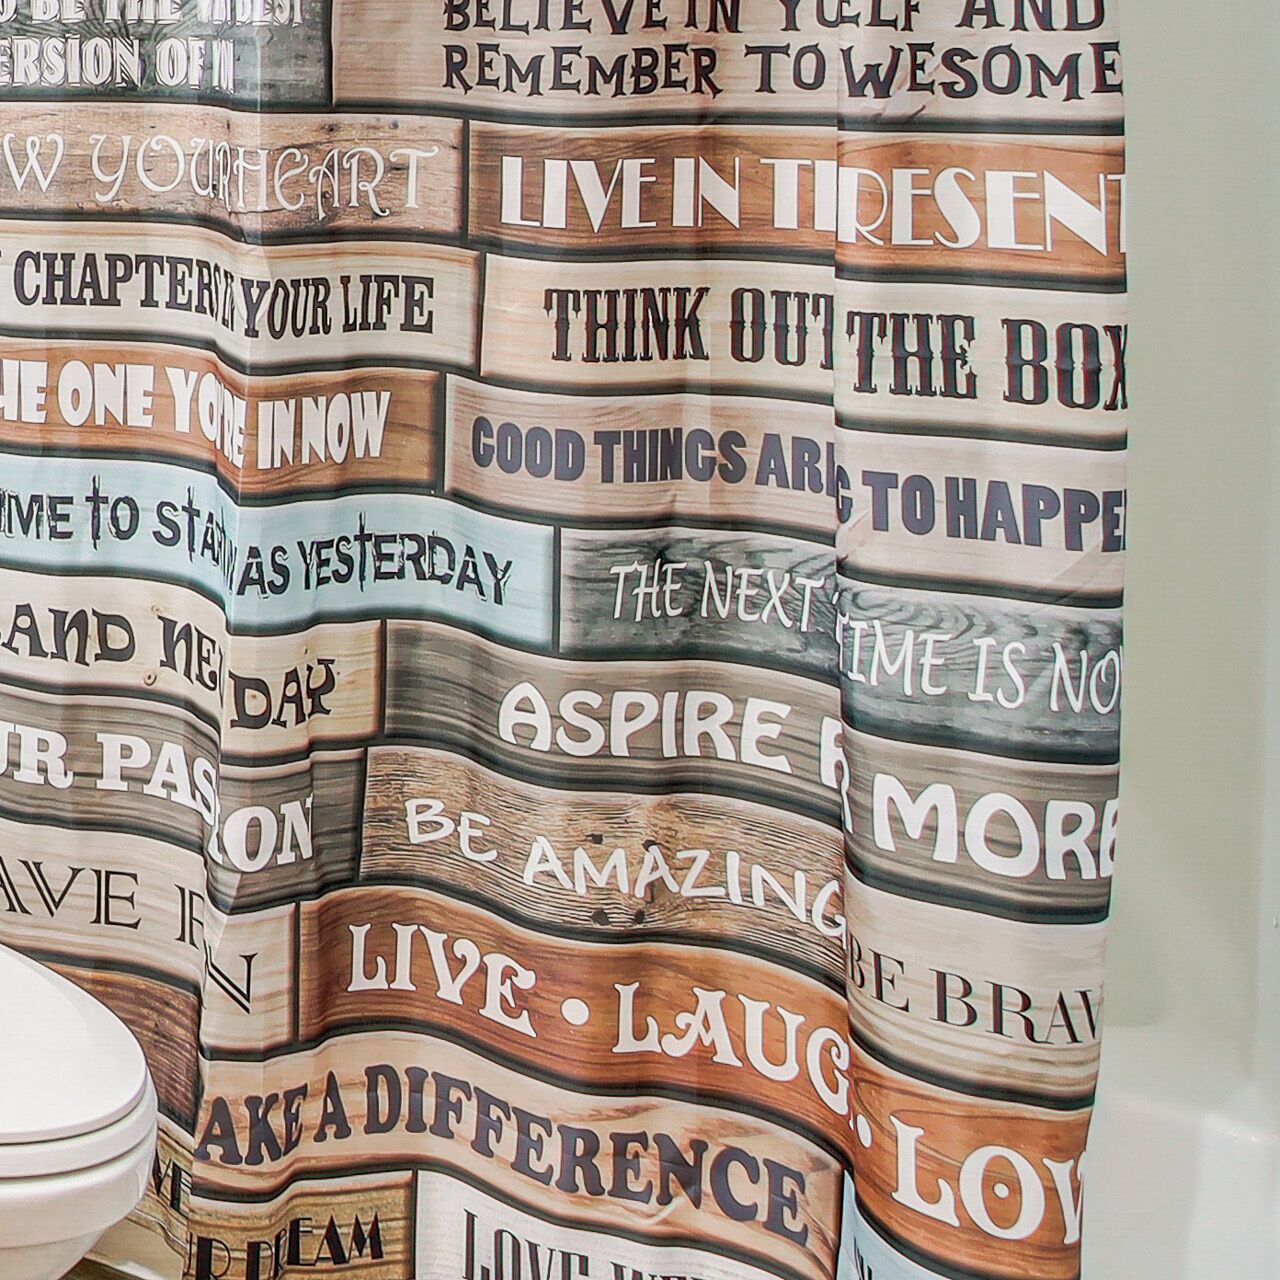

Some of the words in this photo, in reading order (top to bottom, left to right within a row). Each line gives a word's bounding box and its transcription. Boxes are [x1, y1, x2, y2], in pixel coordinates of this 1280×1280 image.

[155, 35, 207, 90] OF
[442, 42, 724, 99] REMEMBER
[744, 42, 827, 94] TO
[233, 145, 441, 221] HEART
[500, 154, 658, 234] LIVE
[671, 154, 741, 230] IN
[239, 275, 333, 341] YOUR
[339, 273, 435, 335] LIFE
[543, 285, 712, 363] THINK
[845, 310, 979, 401] THE
[1000, 317, 1129, 412] BOX
[56, 357, 157, 430] ONE
[256, 396, 298, 472] IN
[300, 389, 392, 467] NOW
[471, 414, 587, 482] GOOD
[592, 425, 749, 485] THINGS
[861, 469, 936, 536] TO
[944, 474, 1128, 554] HAPPE
[157, 613, 225, 708] NE
[228, 657, 338, 730] DAY
[608, 557, 689, 624] THE
[699, 559, 826, 633] NEXT
[966, 637, 1027, 711] IS
[1049, 641, 1124, 716] NO
[497, 681, 793, 775] ASPIRE
[405, 796, 499, 864] BE
[522, 833, 848, 949] AMAZING
[847, 931, 910, 1014] BE
[927, 967, 1106, 1046] BRAV
[346, 921, 538, 1039] LIVE
[889, 1114, 1089, 1247] LOV
[193, 1081, 310, 1167] AKE
[312, 1069, 354, 1144] A
[363, 1063, 810, 1248] DIFFERENCE
